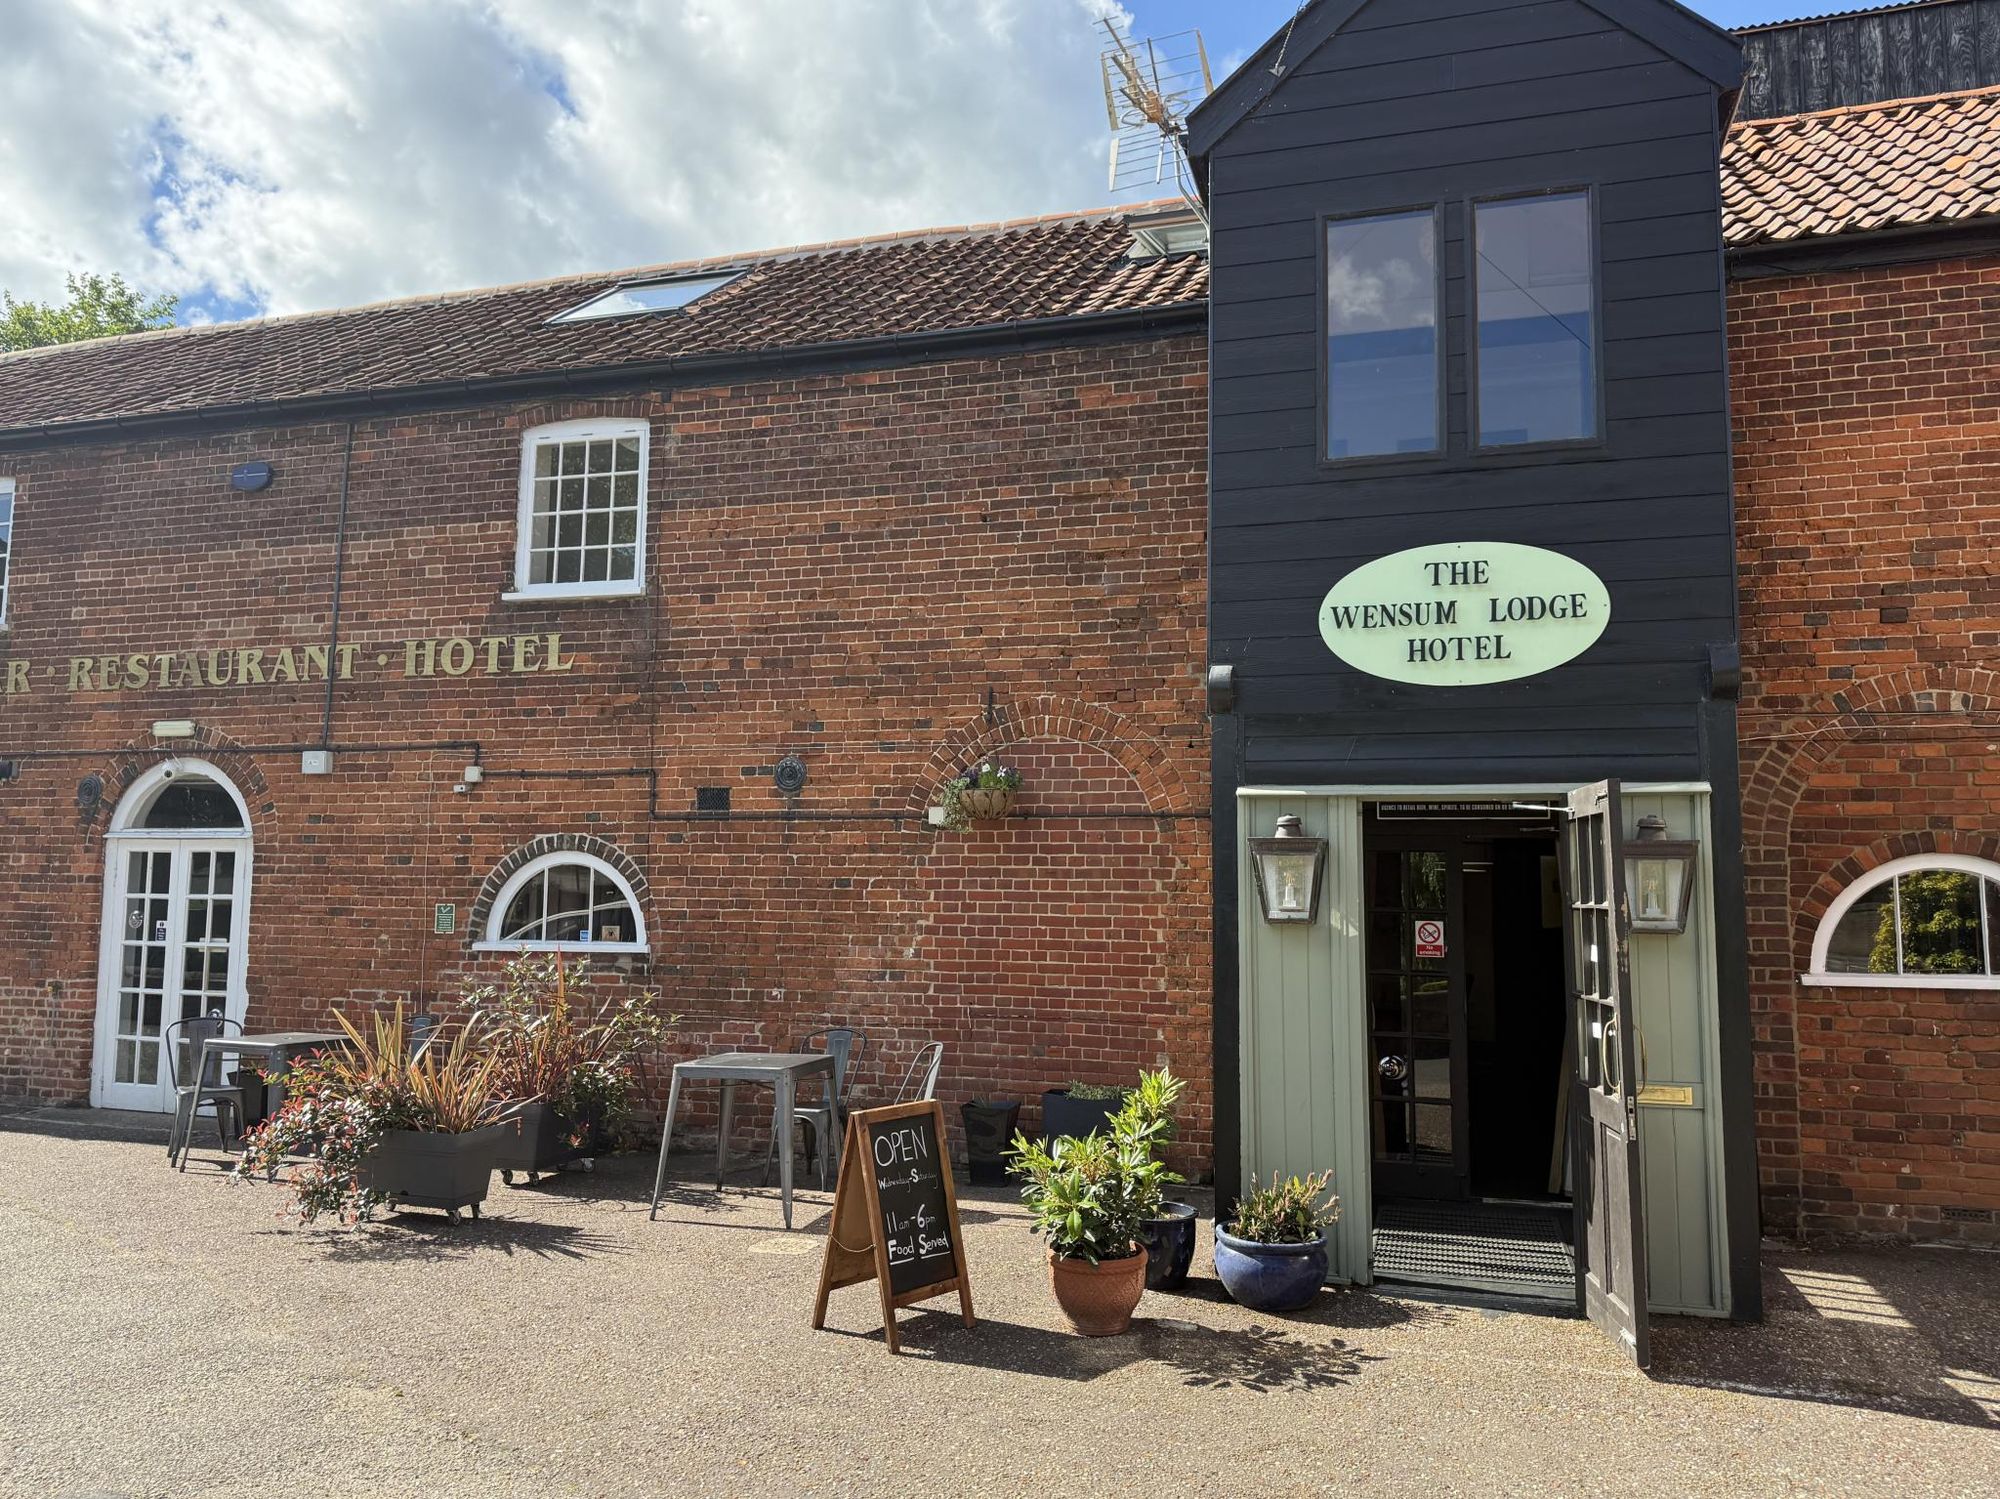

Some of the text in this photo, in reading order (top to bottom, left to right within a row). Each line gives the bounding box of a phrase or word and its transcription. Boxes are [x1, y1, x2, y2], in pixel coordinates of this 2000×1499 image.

[1424, 560, 1490, 586] THE
[1330, 593, 1588, 629] WENSUM LODGE
[0, 633, 576, 694] R RESTAURANT HOTEL
[1407, 635, 1512, 662] HOTEL
[874, 1126, 928, 1167] OPEN
[888, 1230, 949, 1260] Food Served
